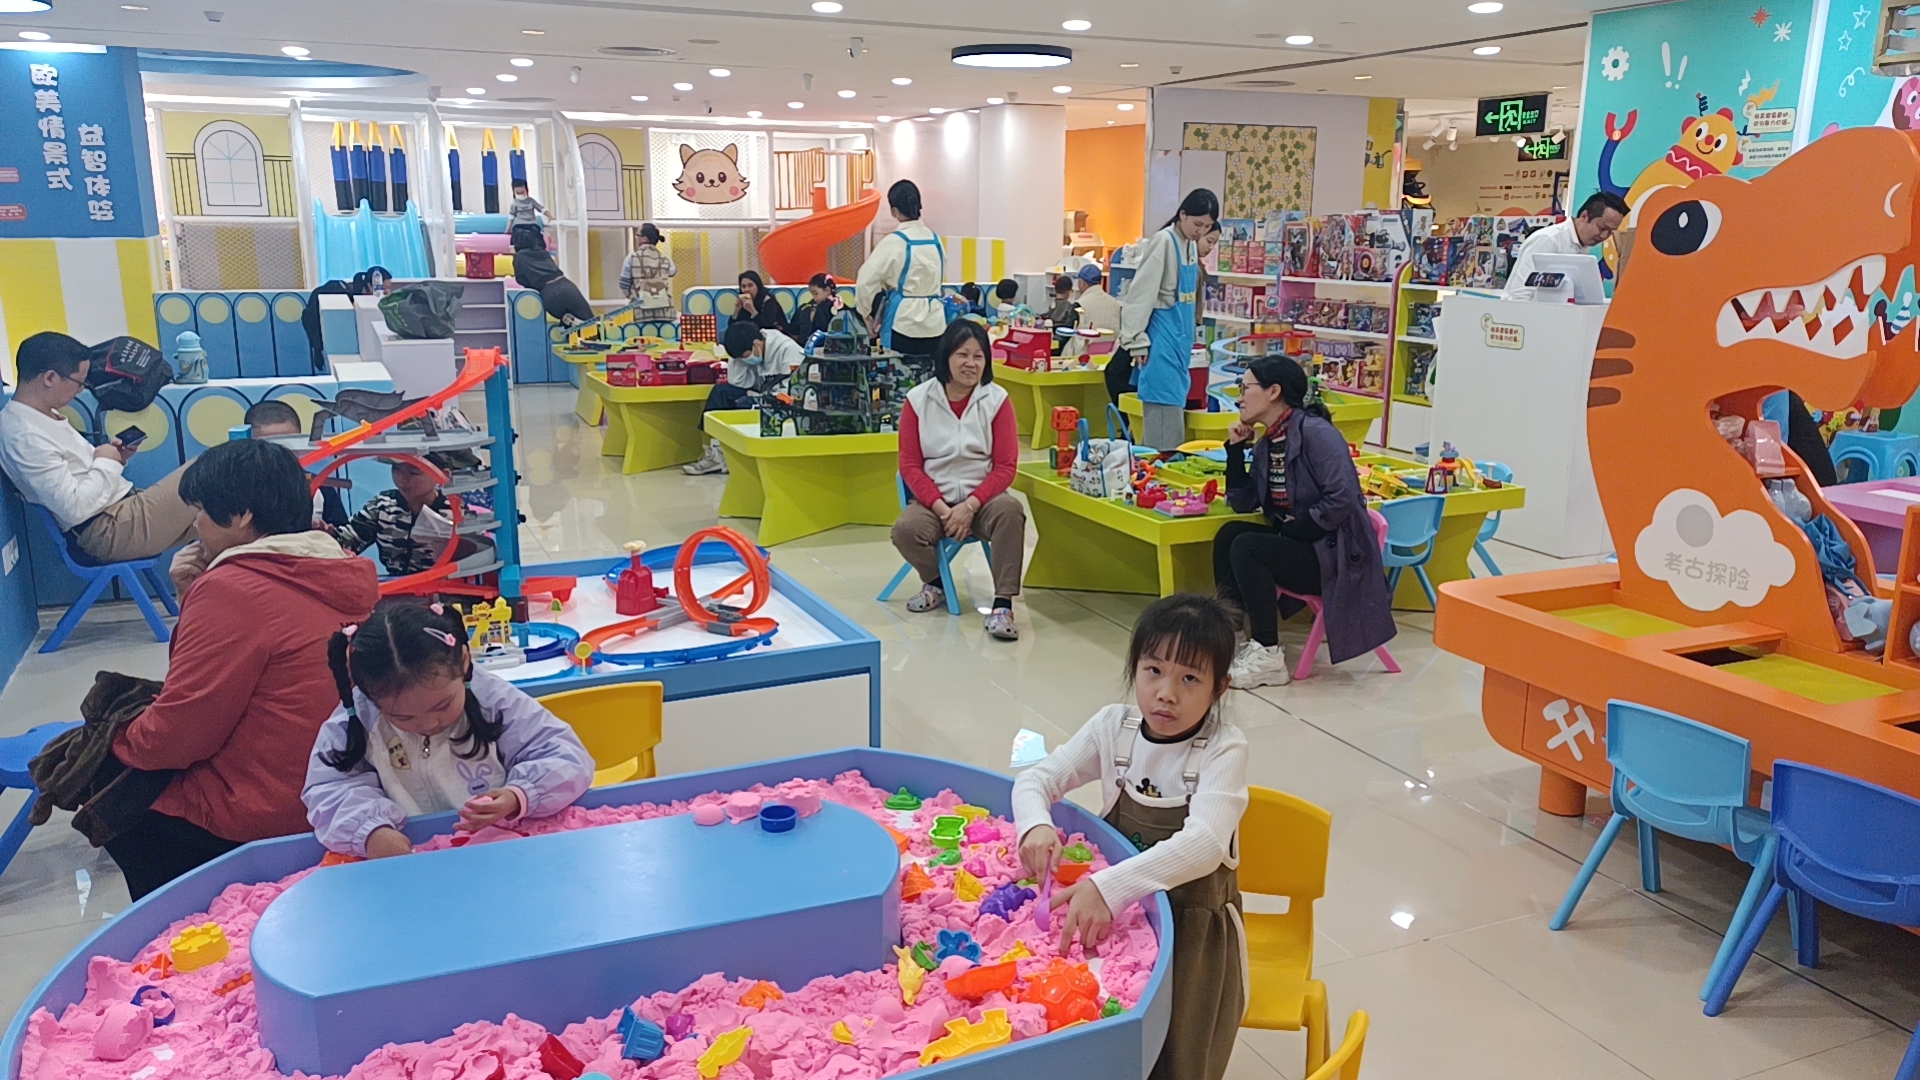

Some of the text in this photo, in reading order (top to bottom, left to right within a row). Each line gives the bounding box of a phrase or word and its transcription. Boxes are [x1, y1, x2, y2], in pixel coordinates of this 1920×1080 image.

[30, 64, 73, 190] 欧美情景式
[78, 123, 114, 221] 益智体验
[1664, 552, 1751, 591] 考古探险
